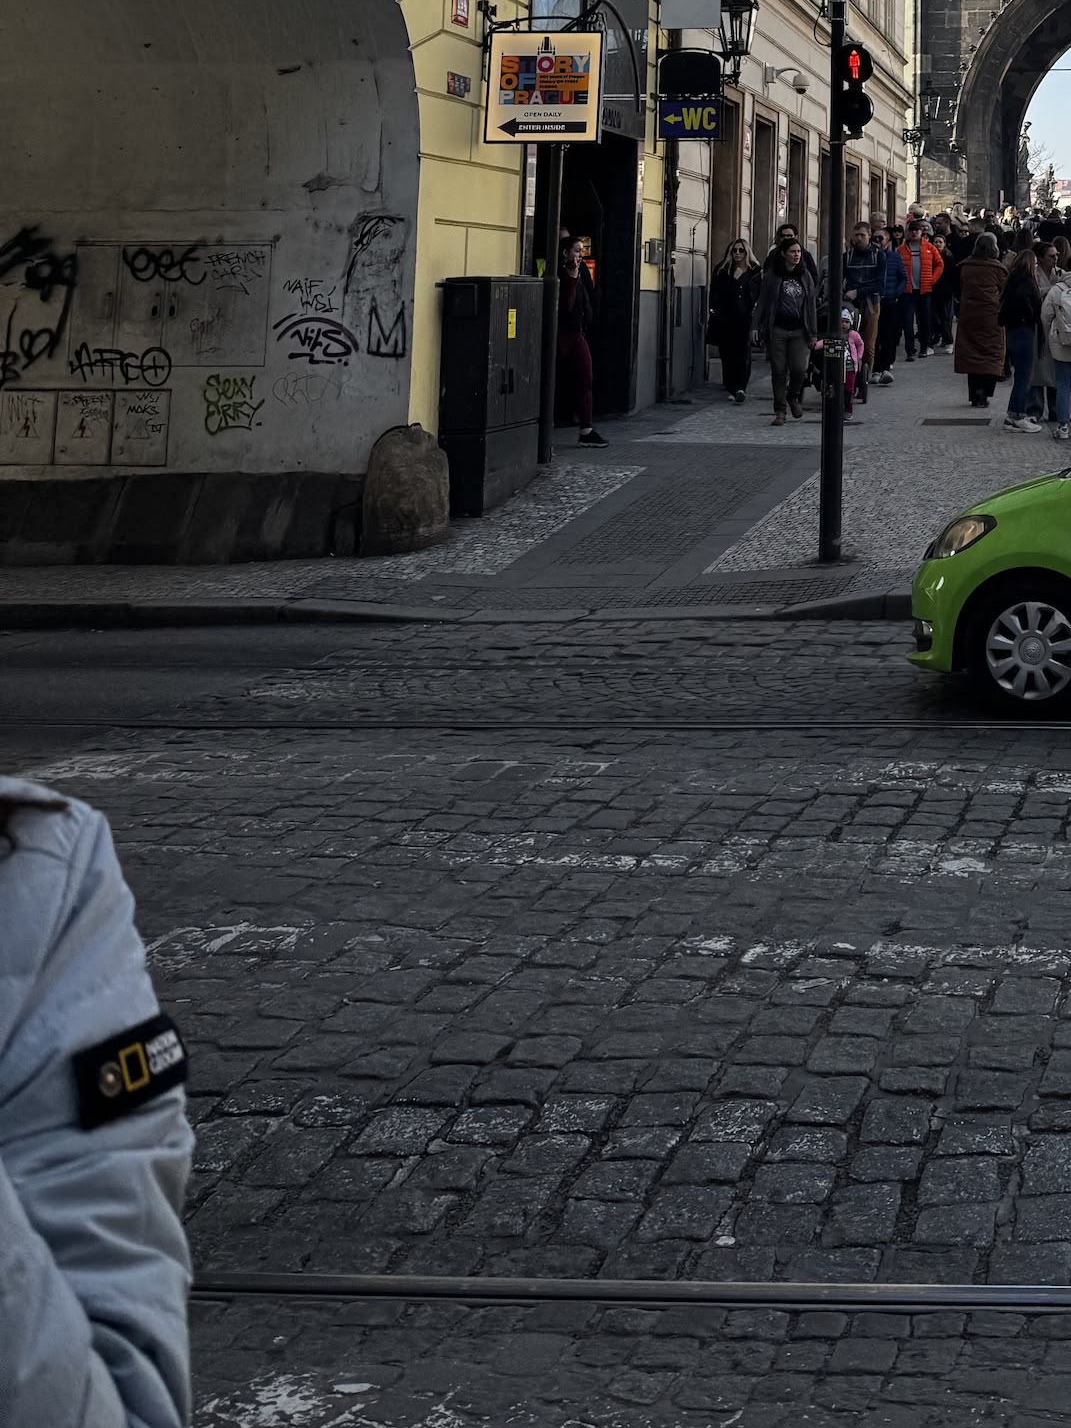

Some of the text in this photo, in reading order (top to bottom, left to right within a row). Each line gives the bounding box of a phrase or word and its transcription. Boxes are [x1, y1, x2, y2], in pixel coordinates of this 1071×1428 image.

[501, 56, 590, 74] STORY
[500, 73, 537, 91] OF
[499, 90, 589, 105] PRAGUE
[681, 106, 718, 131] WC
